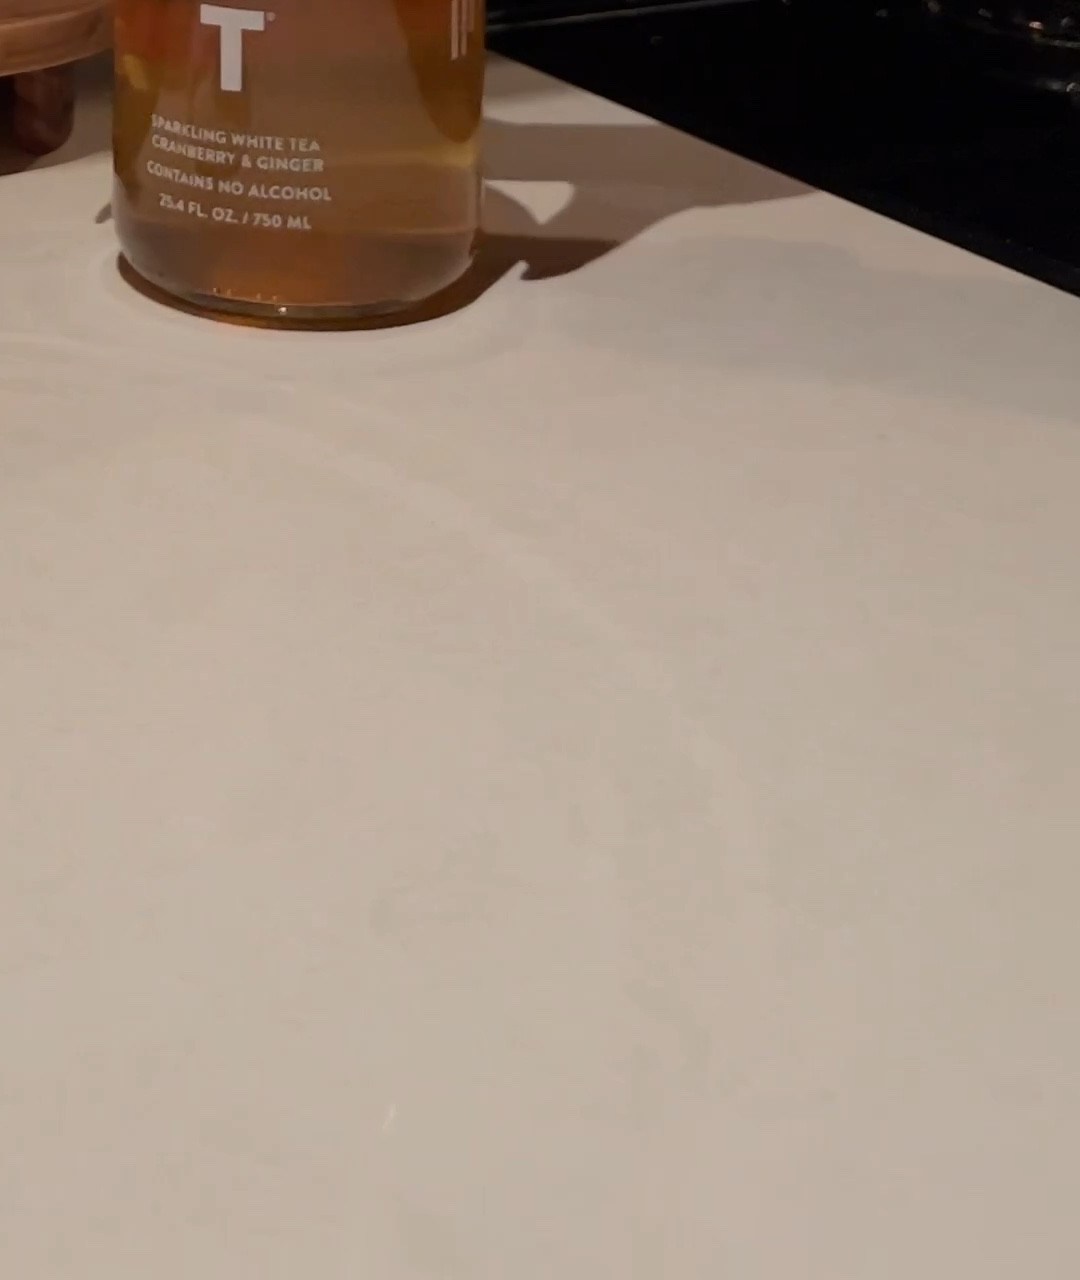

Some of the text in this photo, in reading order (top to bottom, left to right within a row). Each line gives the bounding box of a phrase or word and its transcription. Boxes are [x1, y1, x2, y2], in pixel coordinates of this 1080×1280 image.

[151, 113, 321, 152] SPARKLING WHITE TEA
[151, 134, 324, 172] CRANBERRY & GINGER
[146, 159, 332, 201] CONTAINS NO ALCOHOL
[159, 192, 313, 230] 25.4 FL. OZ. / 750 ML
